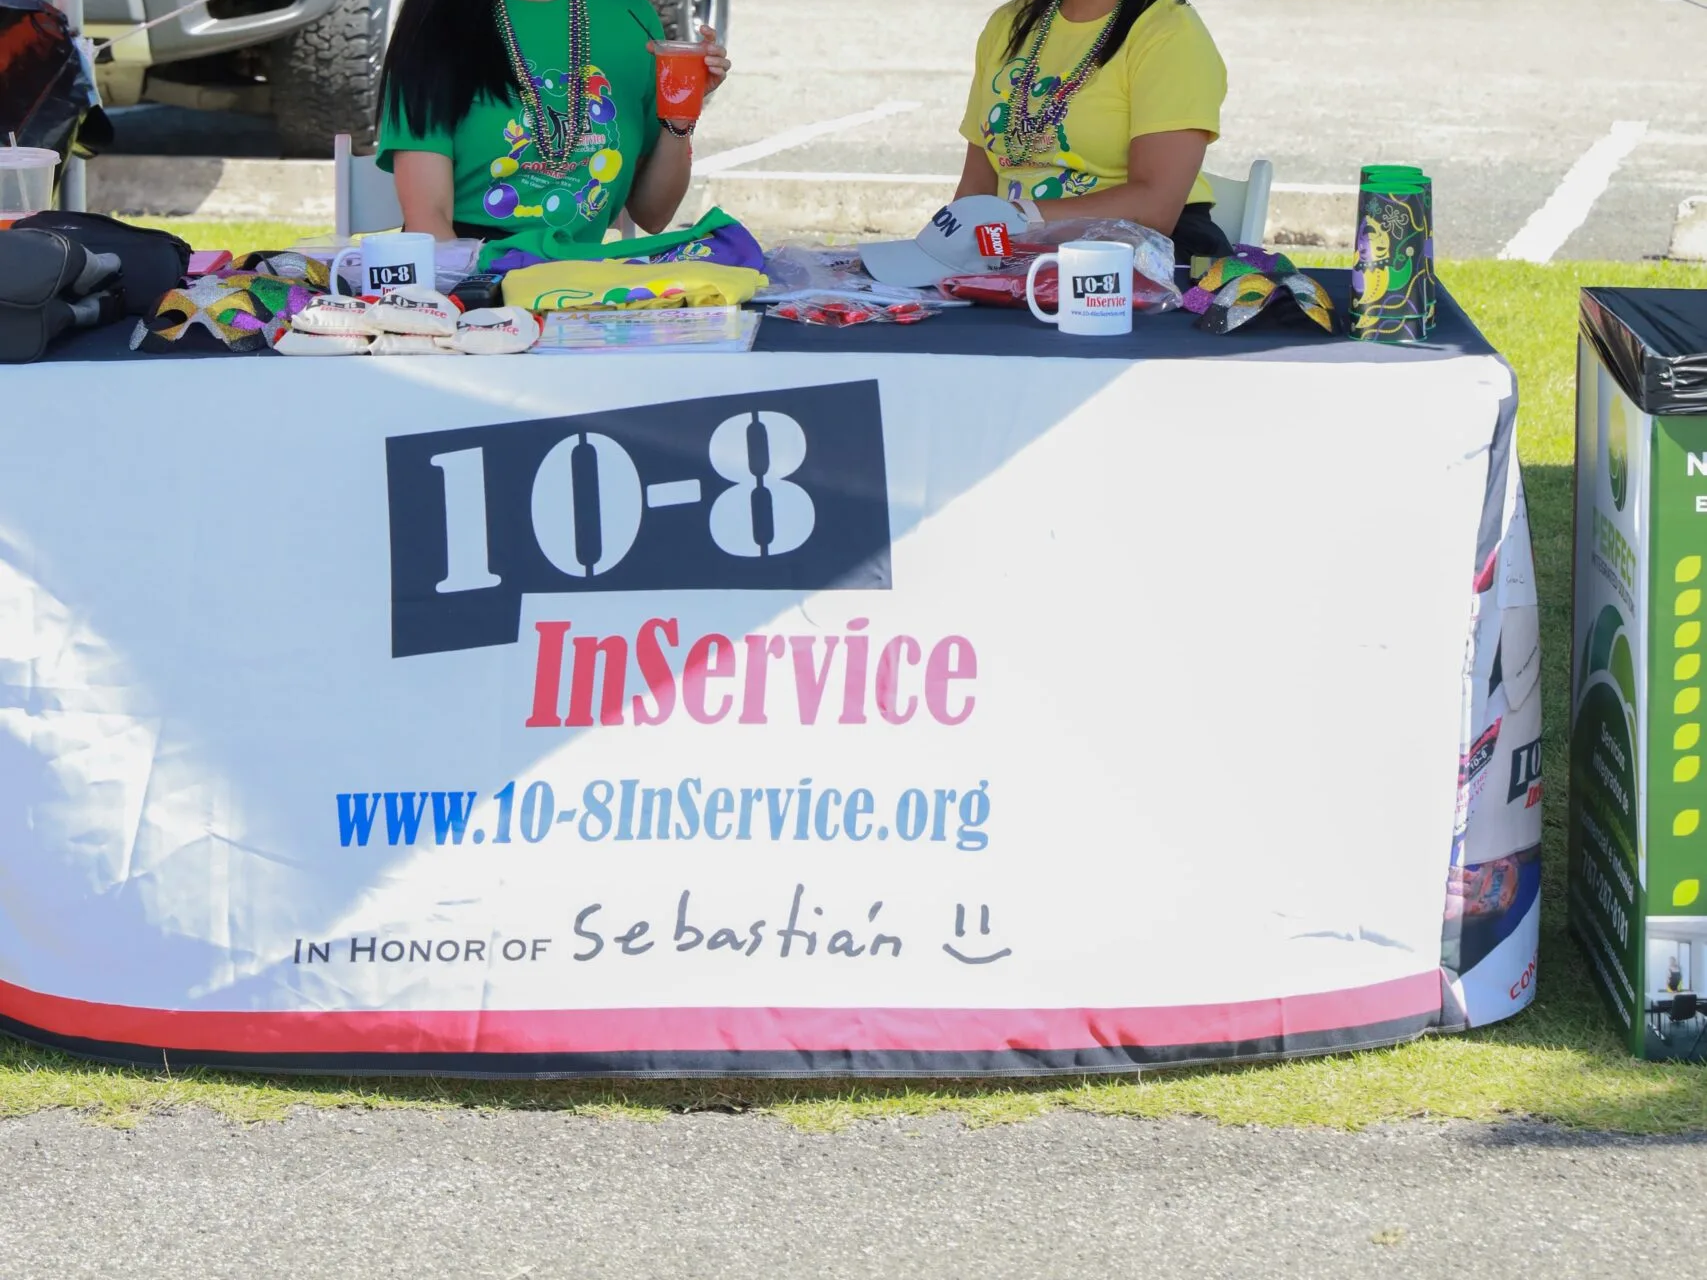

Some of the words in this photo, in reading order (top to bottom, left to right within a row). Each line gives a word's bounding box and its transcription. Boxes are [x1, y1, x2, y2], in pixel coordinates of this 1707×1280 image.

[372, 265, 410, 284] 10-8
[1076, 275, 1114, 293] 10-8
[1086, 296, 1126, 308] InService
[430, 410, 815, 593] 10-8
[526, 617, 978, 728] InService
[336, 777, 991, 851] www.10-8InService.org
[572, 884, 903, 962] Sebastián
